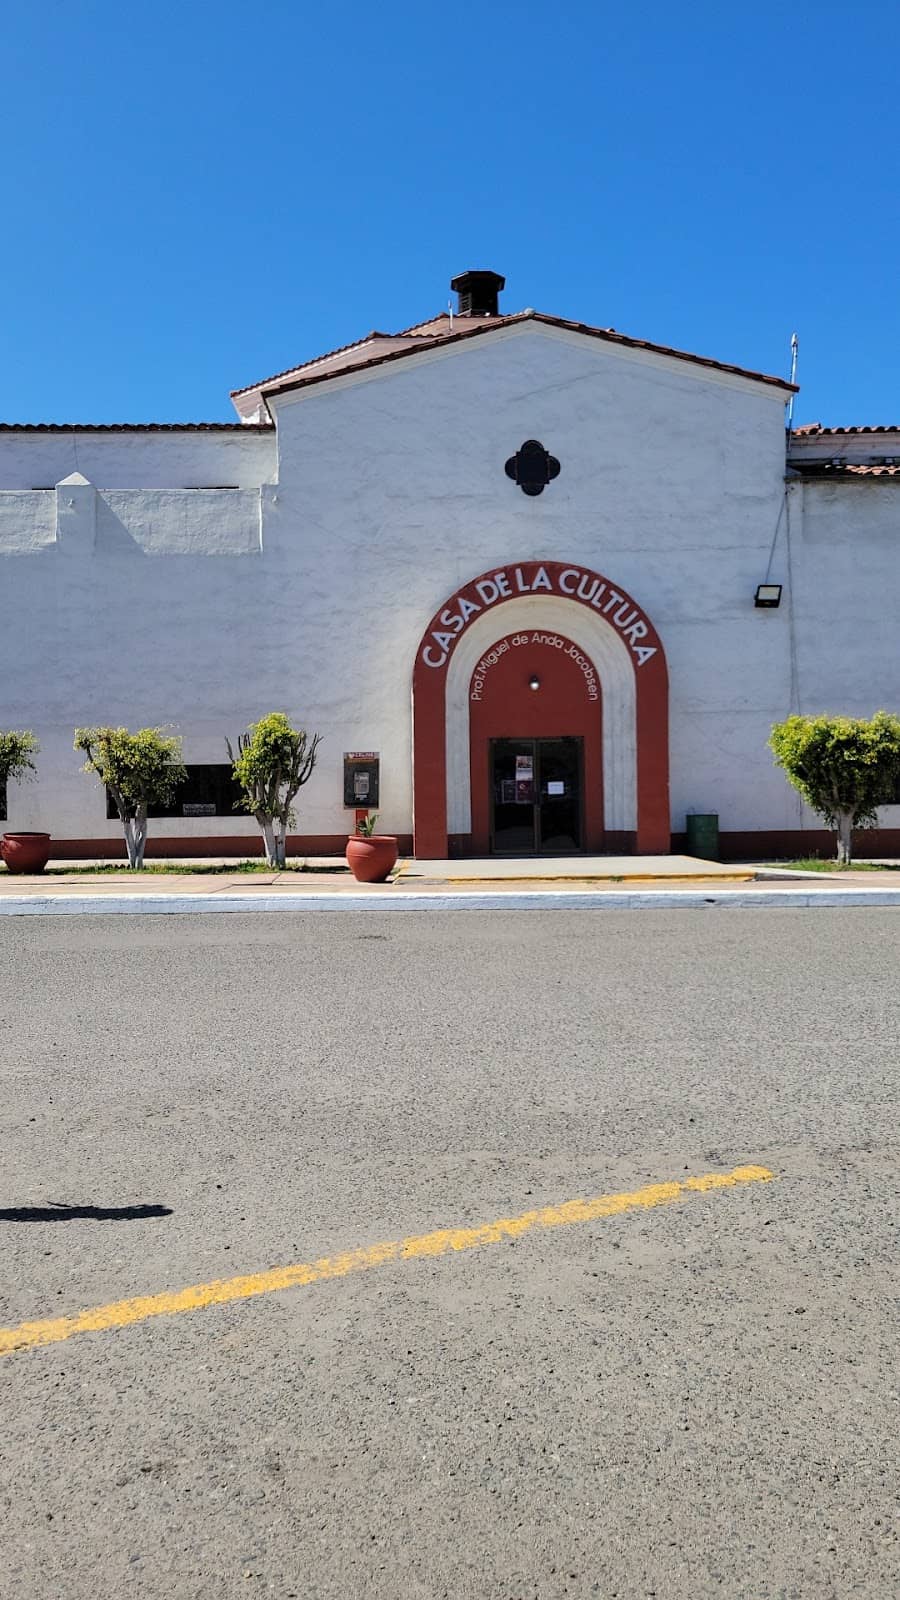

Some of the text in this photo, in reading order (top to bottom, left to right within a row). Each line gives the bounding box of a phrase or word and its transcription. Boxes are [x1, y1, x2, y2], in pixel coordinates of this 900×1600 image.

[423, 566, 657, 668] CASA DE LA CULTURA
[511, 635, 529, 647] de
[531, 632, 564, 649] Anda
[564, 645, 598, 701] Jacobsen
